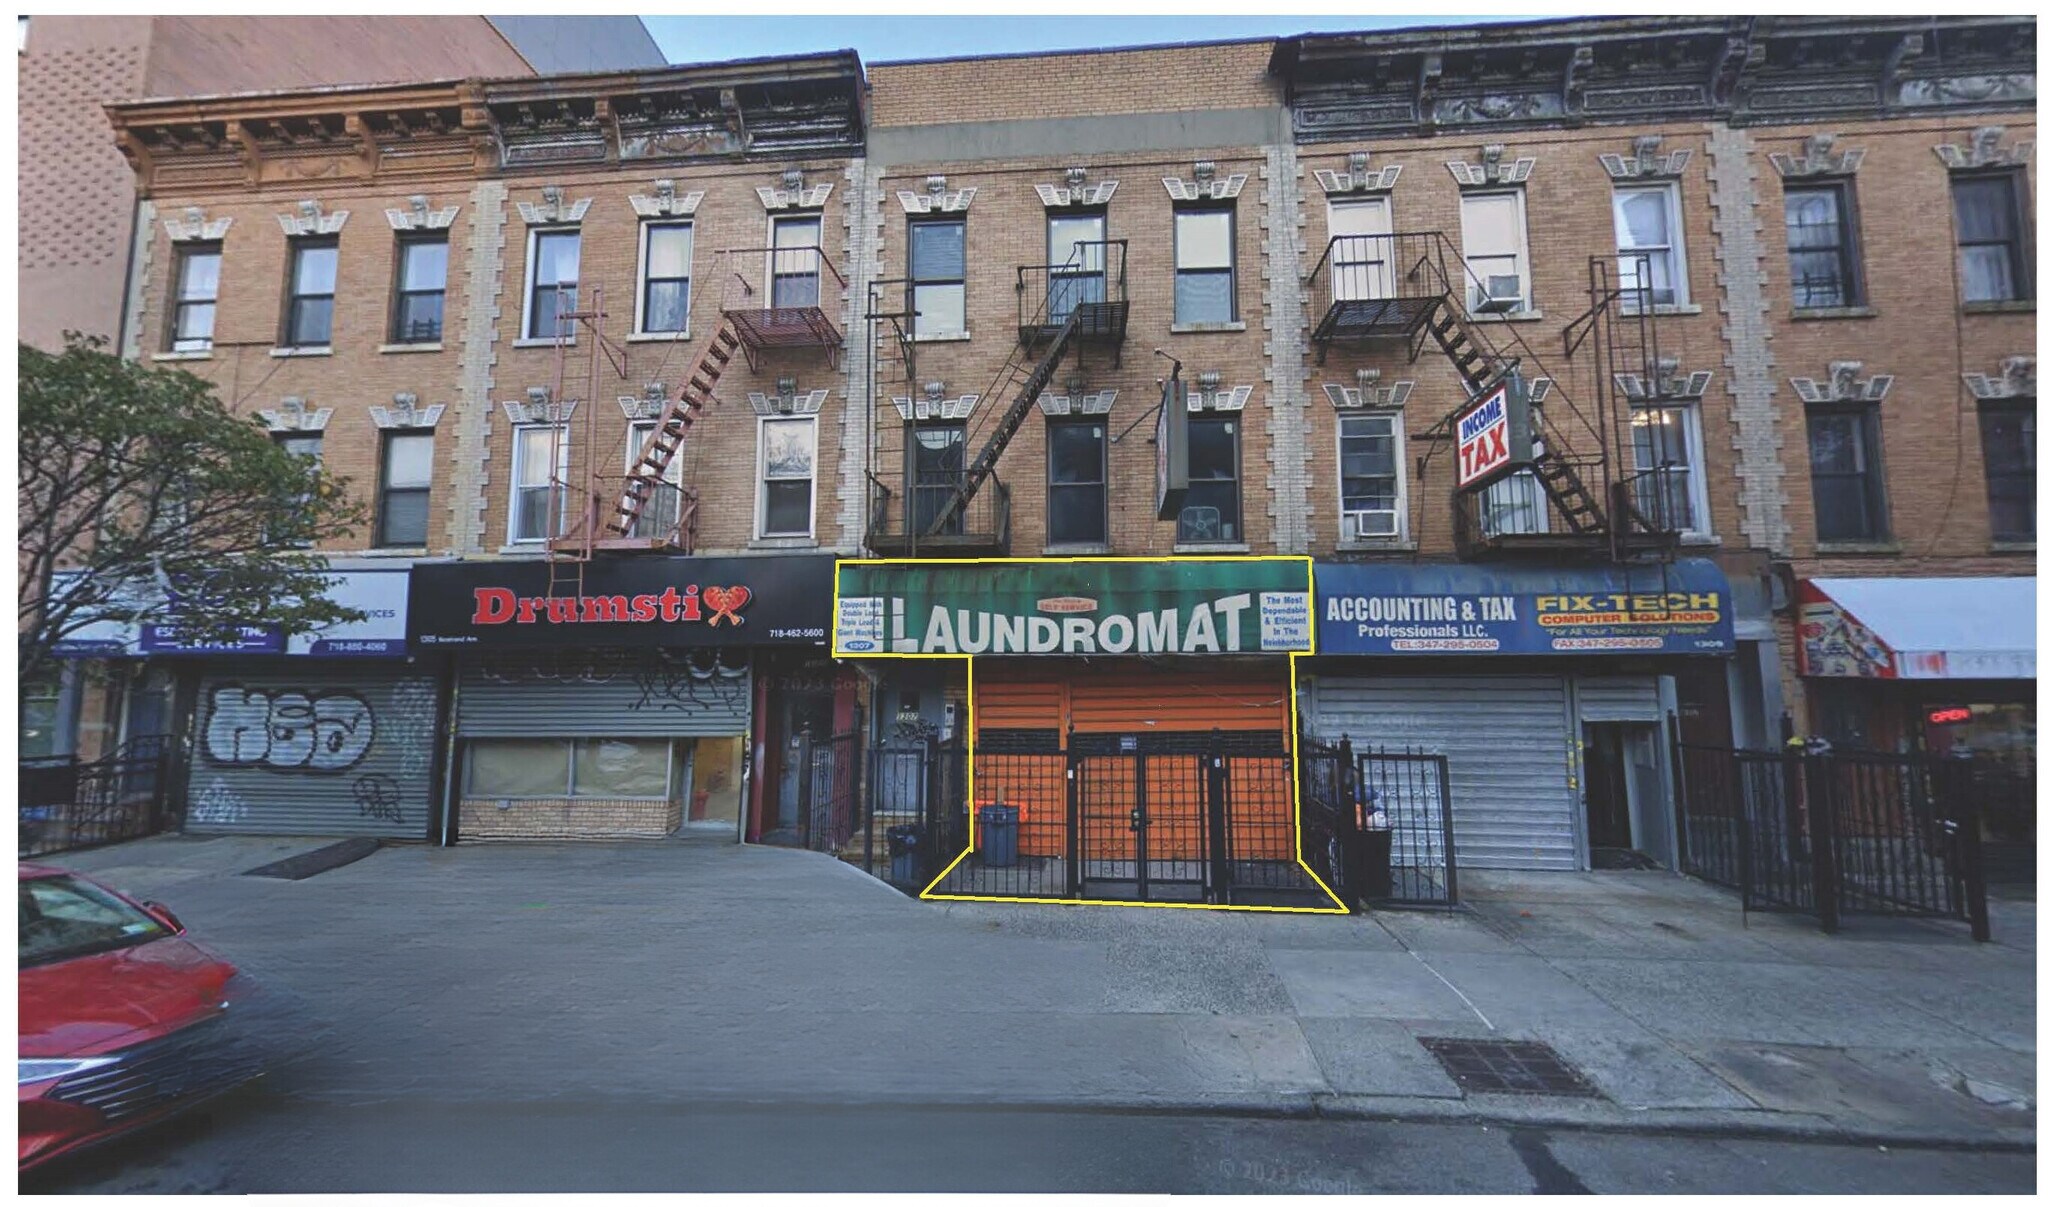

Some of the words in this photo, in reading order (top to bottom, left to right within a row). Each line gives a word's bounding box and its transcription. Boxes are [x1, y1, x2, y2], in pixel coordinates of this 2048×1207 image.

[1462, 396, 1502, 440] INCOME
[1461, 421, 1507, 478] TAX
[1266, 596, 1280, 604] The
[1284, 596, 1302, 604] Most
[1536, 592, 1719, 612] FIX-TECH
[1327, 597, 1457, 621] ACCOUNTING
[1461, 600, 1476, 621] &
[1479, 597, 1517, 621] TAX
[890, 593, 1251, 653] LAUNDROMAT
[1541, 613, 1622, 625] COMPUTER
[769, 629, 824, 638] 718-462-5600
[1358, 624, 1458, 638] Professionals
[1462, 625, 1489, 637] LLC.
[848, 641, 871, 649] 1307
[1931, 708, 1970, 722] OPEN
